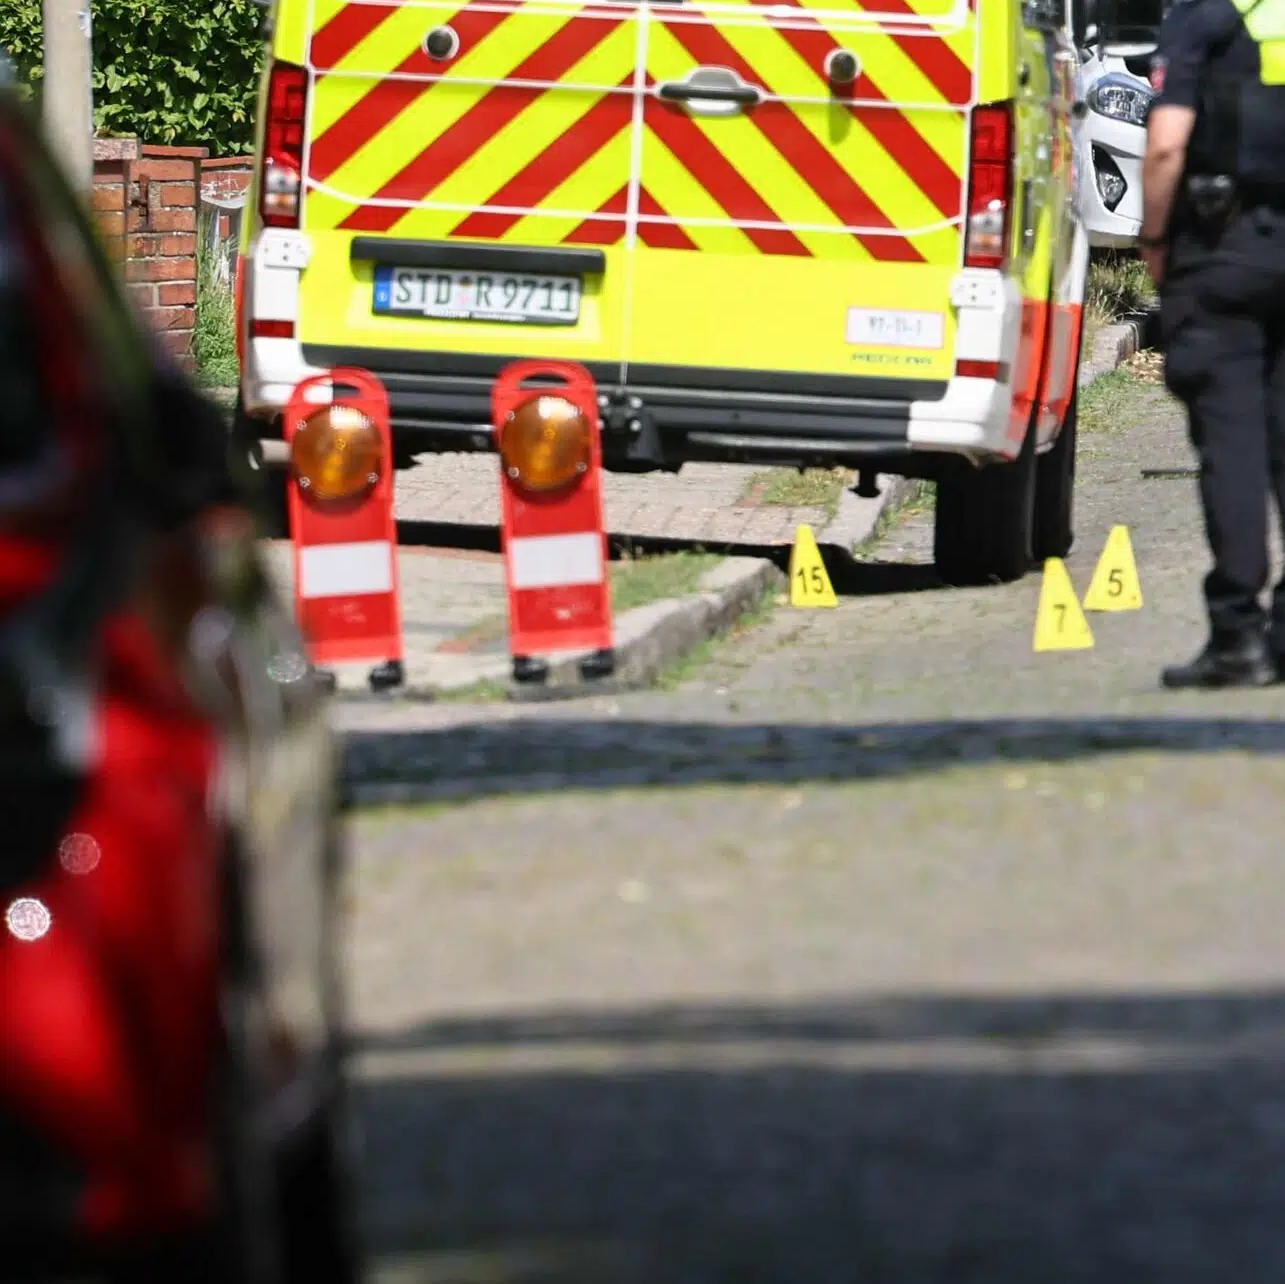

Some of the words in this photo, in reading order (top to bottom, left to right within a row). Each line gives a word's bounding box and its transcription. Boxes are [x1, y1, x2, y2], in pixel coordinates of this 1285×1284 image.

[395, 272, 452, 305] STD
[475, 275, 491, 308] R
[502, 278, 574, 313] 9711
[797, 566, 824, 594] 15
[1107, 568, 1124, 598] 5
[1052, 603, 1067, 633] 7
